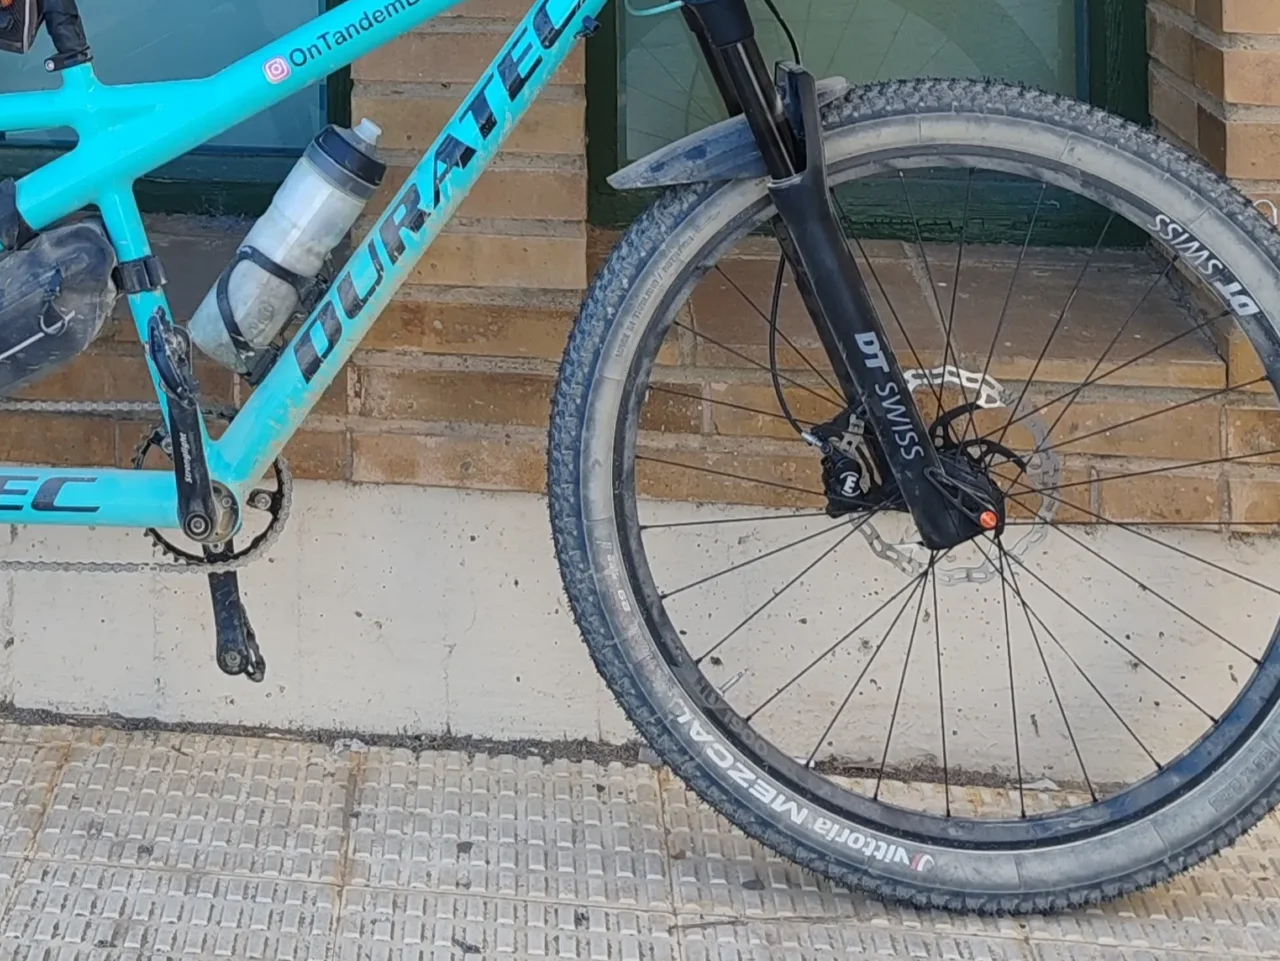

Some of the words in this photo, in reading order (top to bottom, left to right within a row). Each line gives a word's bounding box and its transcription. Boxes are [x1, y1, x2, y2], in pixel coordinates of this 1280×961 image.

[1146, 214, 1224, 275] SWISS
[1212, 281, 1260, 316] DT
[854, 330, 890, 373] DT
[875, 382, 924, 470] SWISS
[669, 697, 808, 825] MEZCAL
